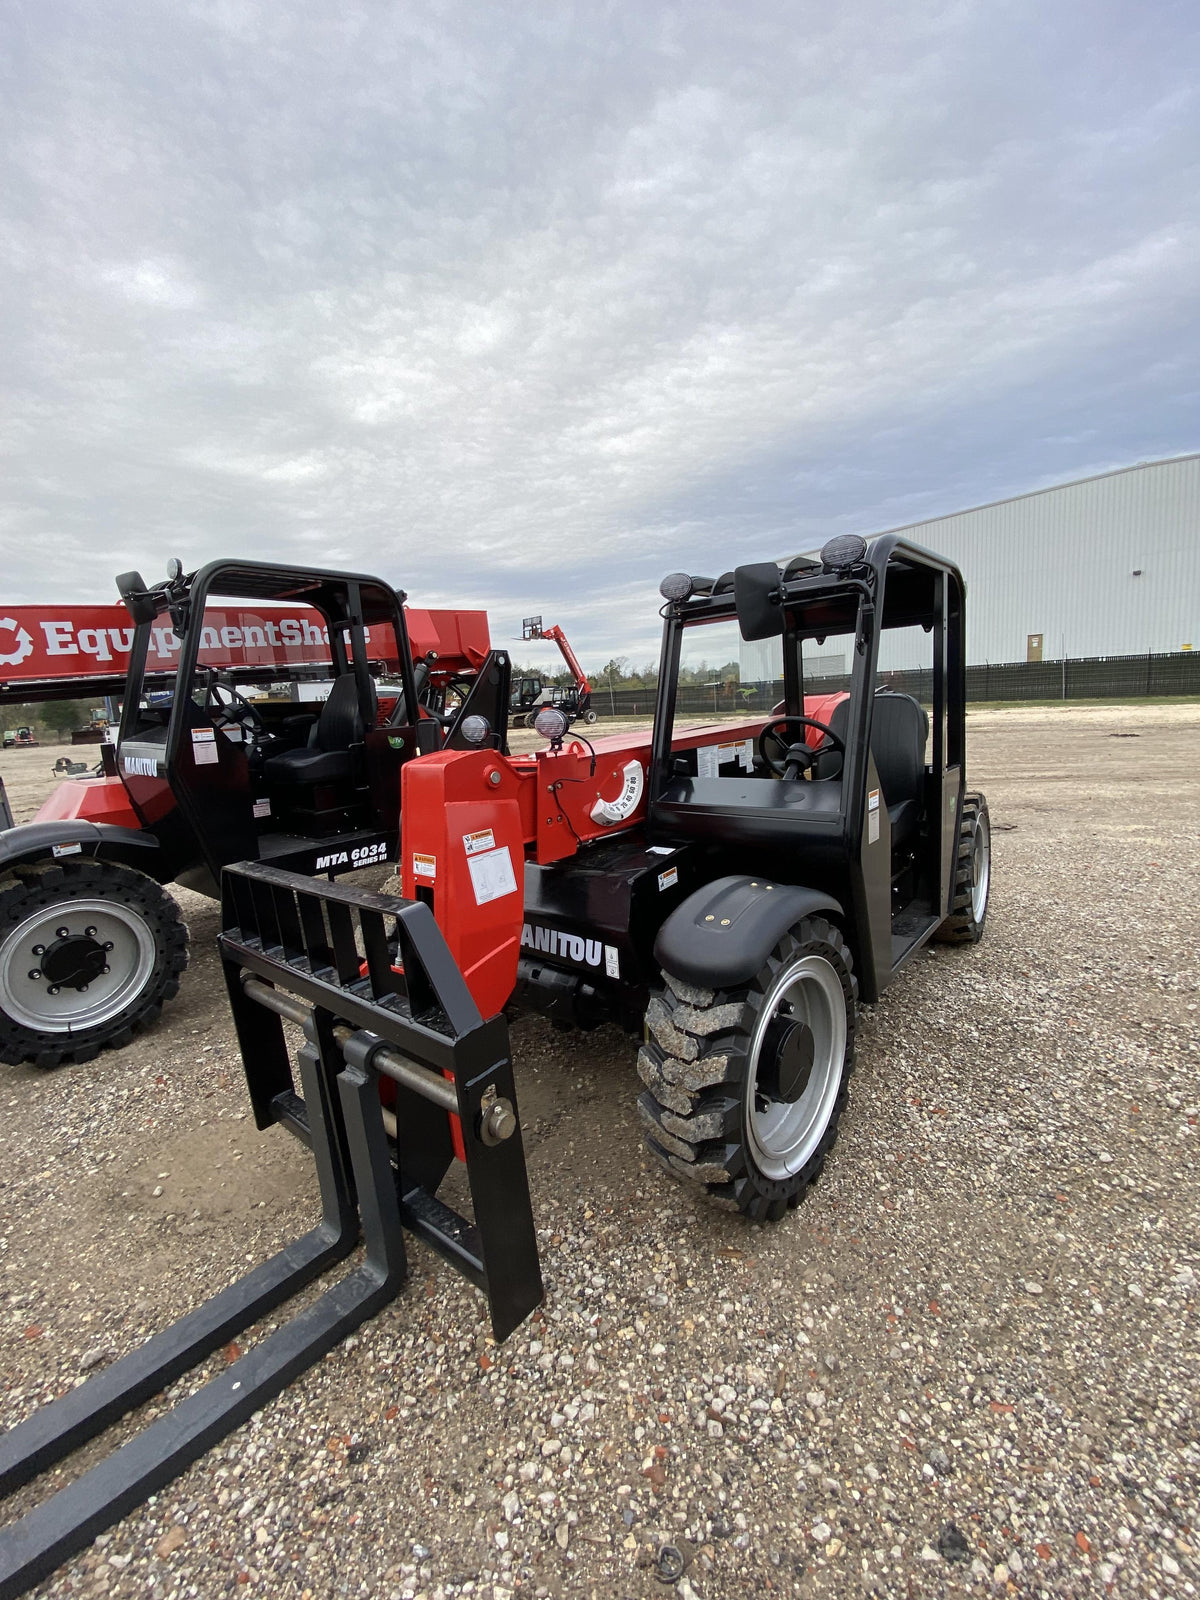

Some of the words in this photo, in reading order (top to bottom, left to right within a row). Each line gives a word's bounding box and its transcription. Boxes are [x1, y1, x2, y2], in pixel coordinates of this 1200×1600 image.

[40, 617, 371, 661] EqupmentSh
[124, 757, 158, 777] MANITOU
[316, 851, 348, 869] MTA
[351, 842, 387, 860] 6034
[353, 855, 379, 868] SERIES
[379, 853, 387, 861] III
[520, 923, 602, 966] ANITOU
